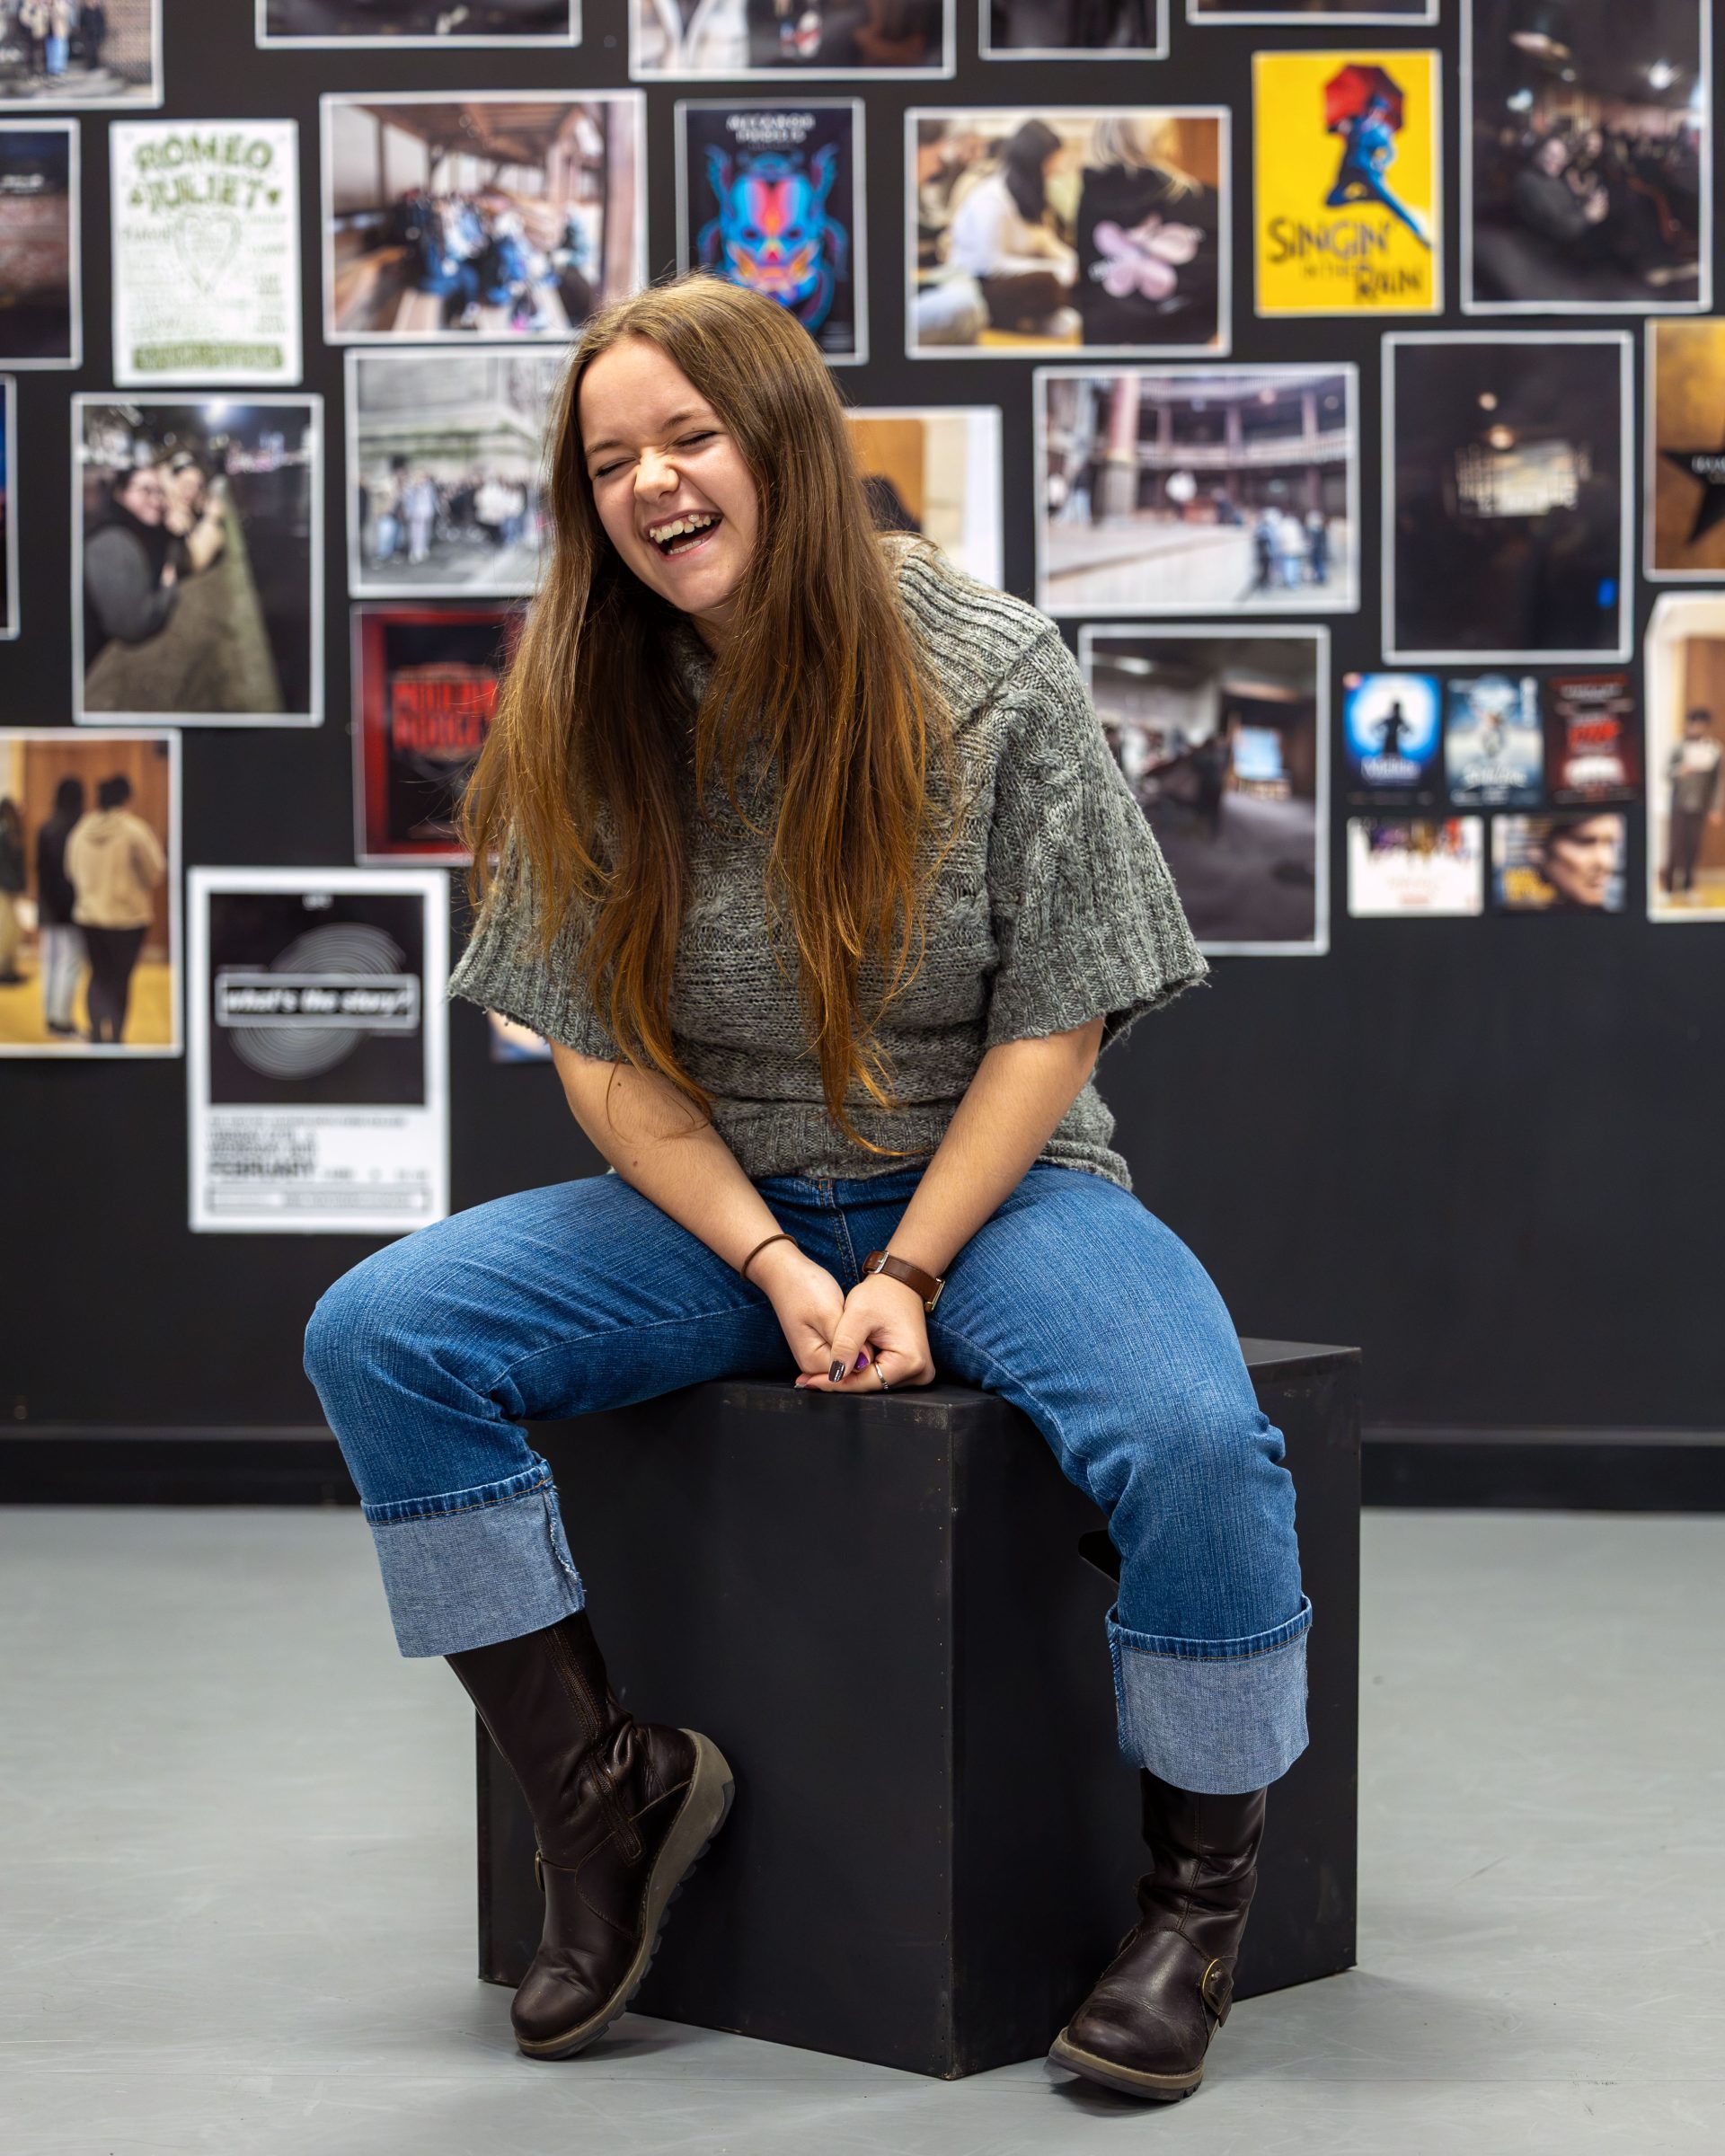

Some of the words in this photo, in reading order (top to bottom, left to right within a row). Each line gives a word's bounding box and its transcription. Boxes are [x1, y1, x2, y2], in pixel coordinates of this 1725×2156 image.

[134, 134, 273, 171] ROMEO
[147, 177, 262, 212] JULIET
[1355, 262, 1421, 302] RAIN
[301, 988, 339, 1013] the
